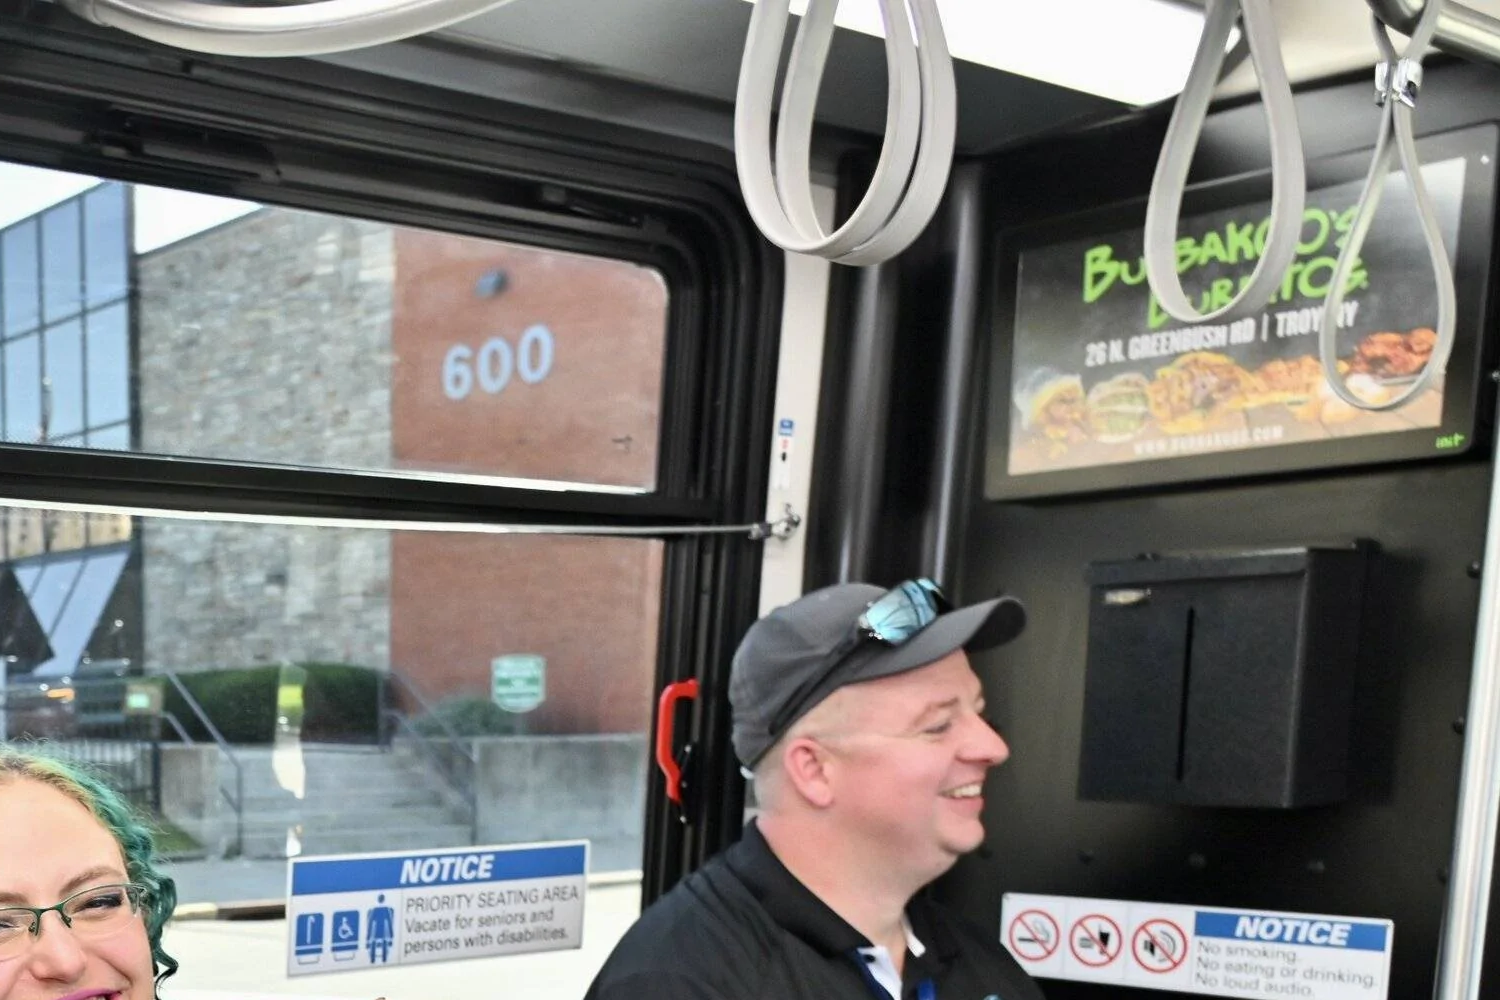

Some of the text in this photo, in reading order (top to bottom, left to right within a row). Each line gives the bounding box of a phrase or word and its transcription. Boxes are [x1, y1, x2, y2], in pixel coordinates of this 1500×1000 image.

[1084, 341, 1107, 367] 26
[1127, 325, 1228, 361] GREENBUSH
[1229, 317, 1256, 345] RD
[442, 324, 554, 400] 600
[400, 854, 495, 884] NOTICE
[405, 885, 579, 914] PRIORITY SEATING AREA
[405, 908, 554, 934] Vacate for seniors and
[1235, 915, 1353, 946] NOTICE
[403, 926, 568, 955] persons with disabilities.
[1199, 941, 1220, 953] No
[1197, 956, 1220, 970] No
[1224, 959, 1275, 979] eating
[1280, 967, 1299, 979] or
[1195, 972, 1315, 997] No loud audio.
